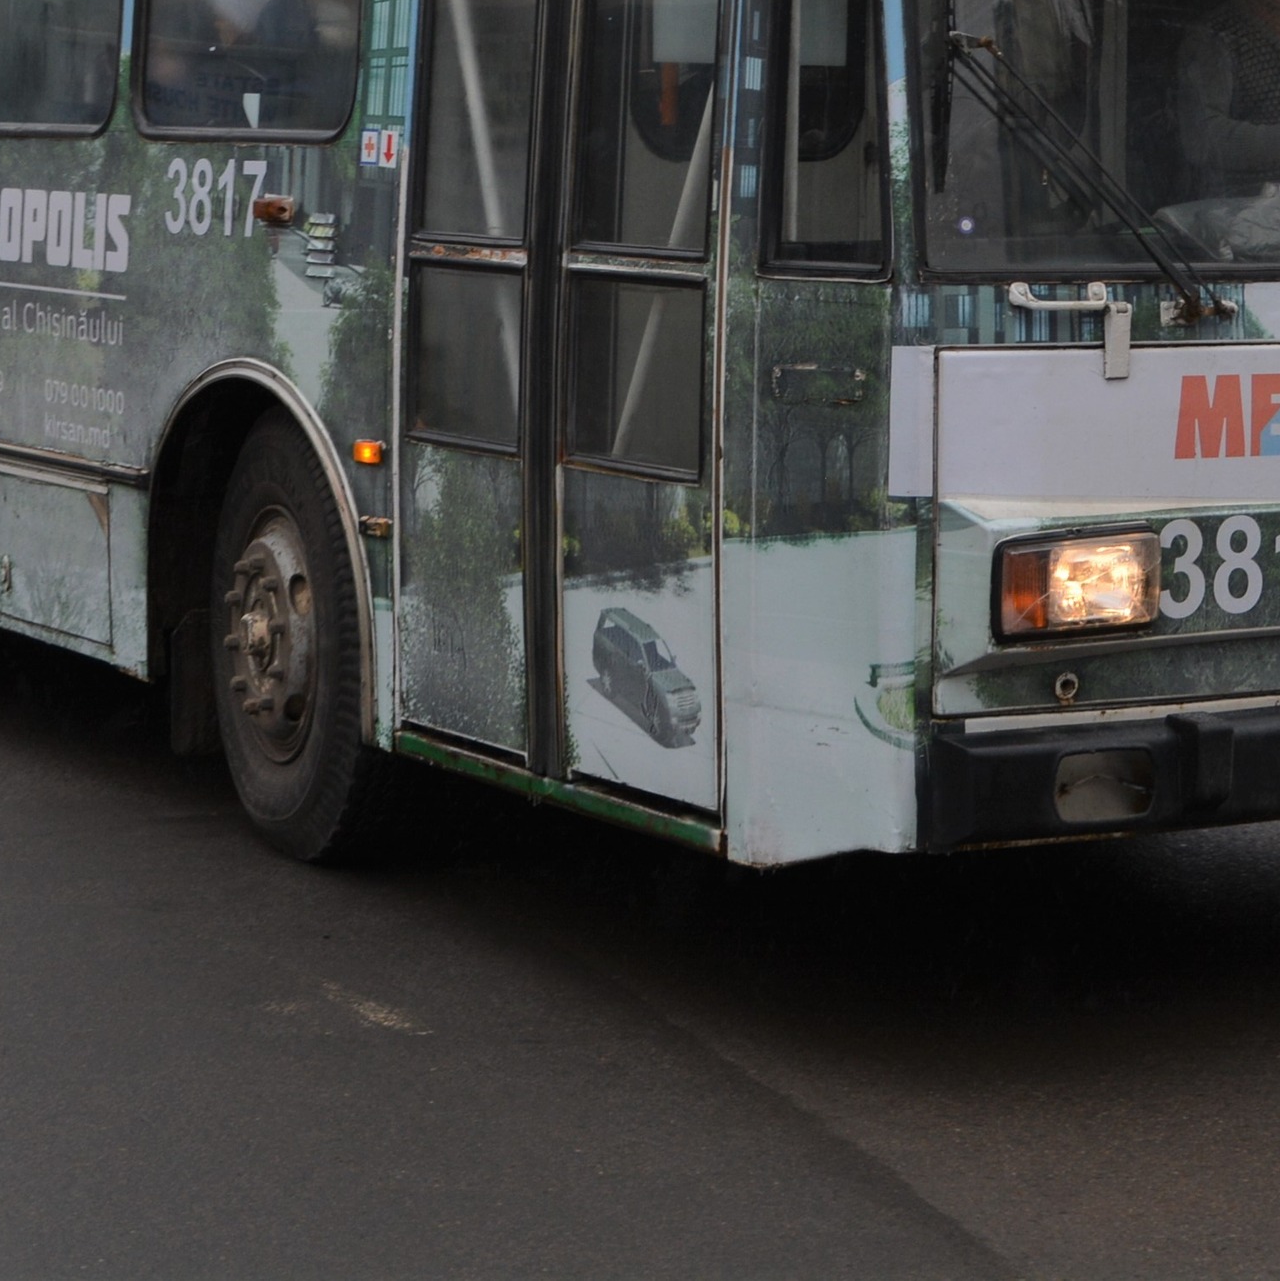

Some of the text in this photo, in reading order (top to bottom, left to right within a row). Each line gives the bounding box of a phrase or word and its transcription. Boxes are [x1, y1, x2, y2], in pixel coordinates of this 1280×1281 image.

[165, 157, 268, 237] 3817
[1, 299, 17, 331] al
[45, 379, 125, 415] 079 00 1000
[44, 412, 111, 449] kirsan.md
